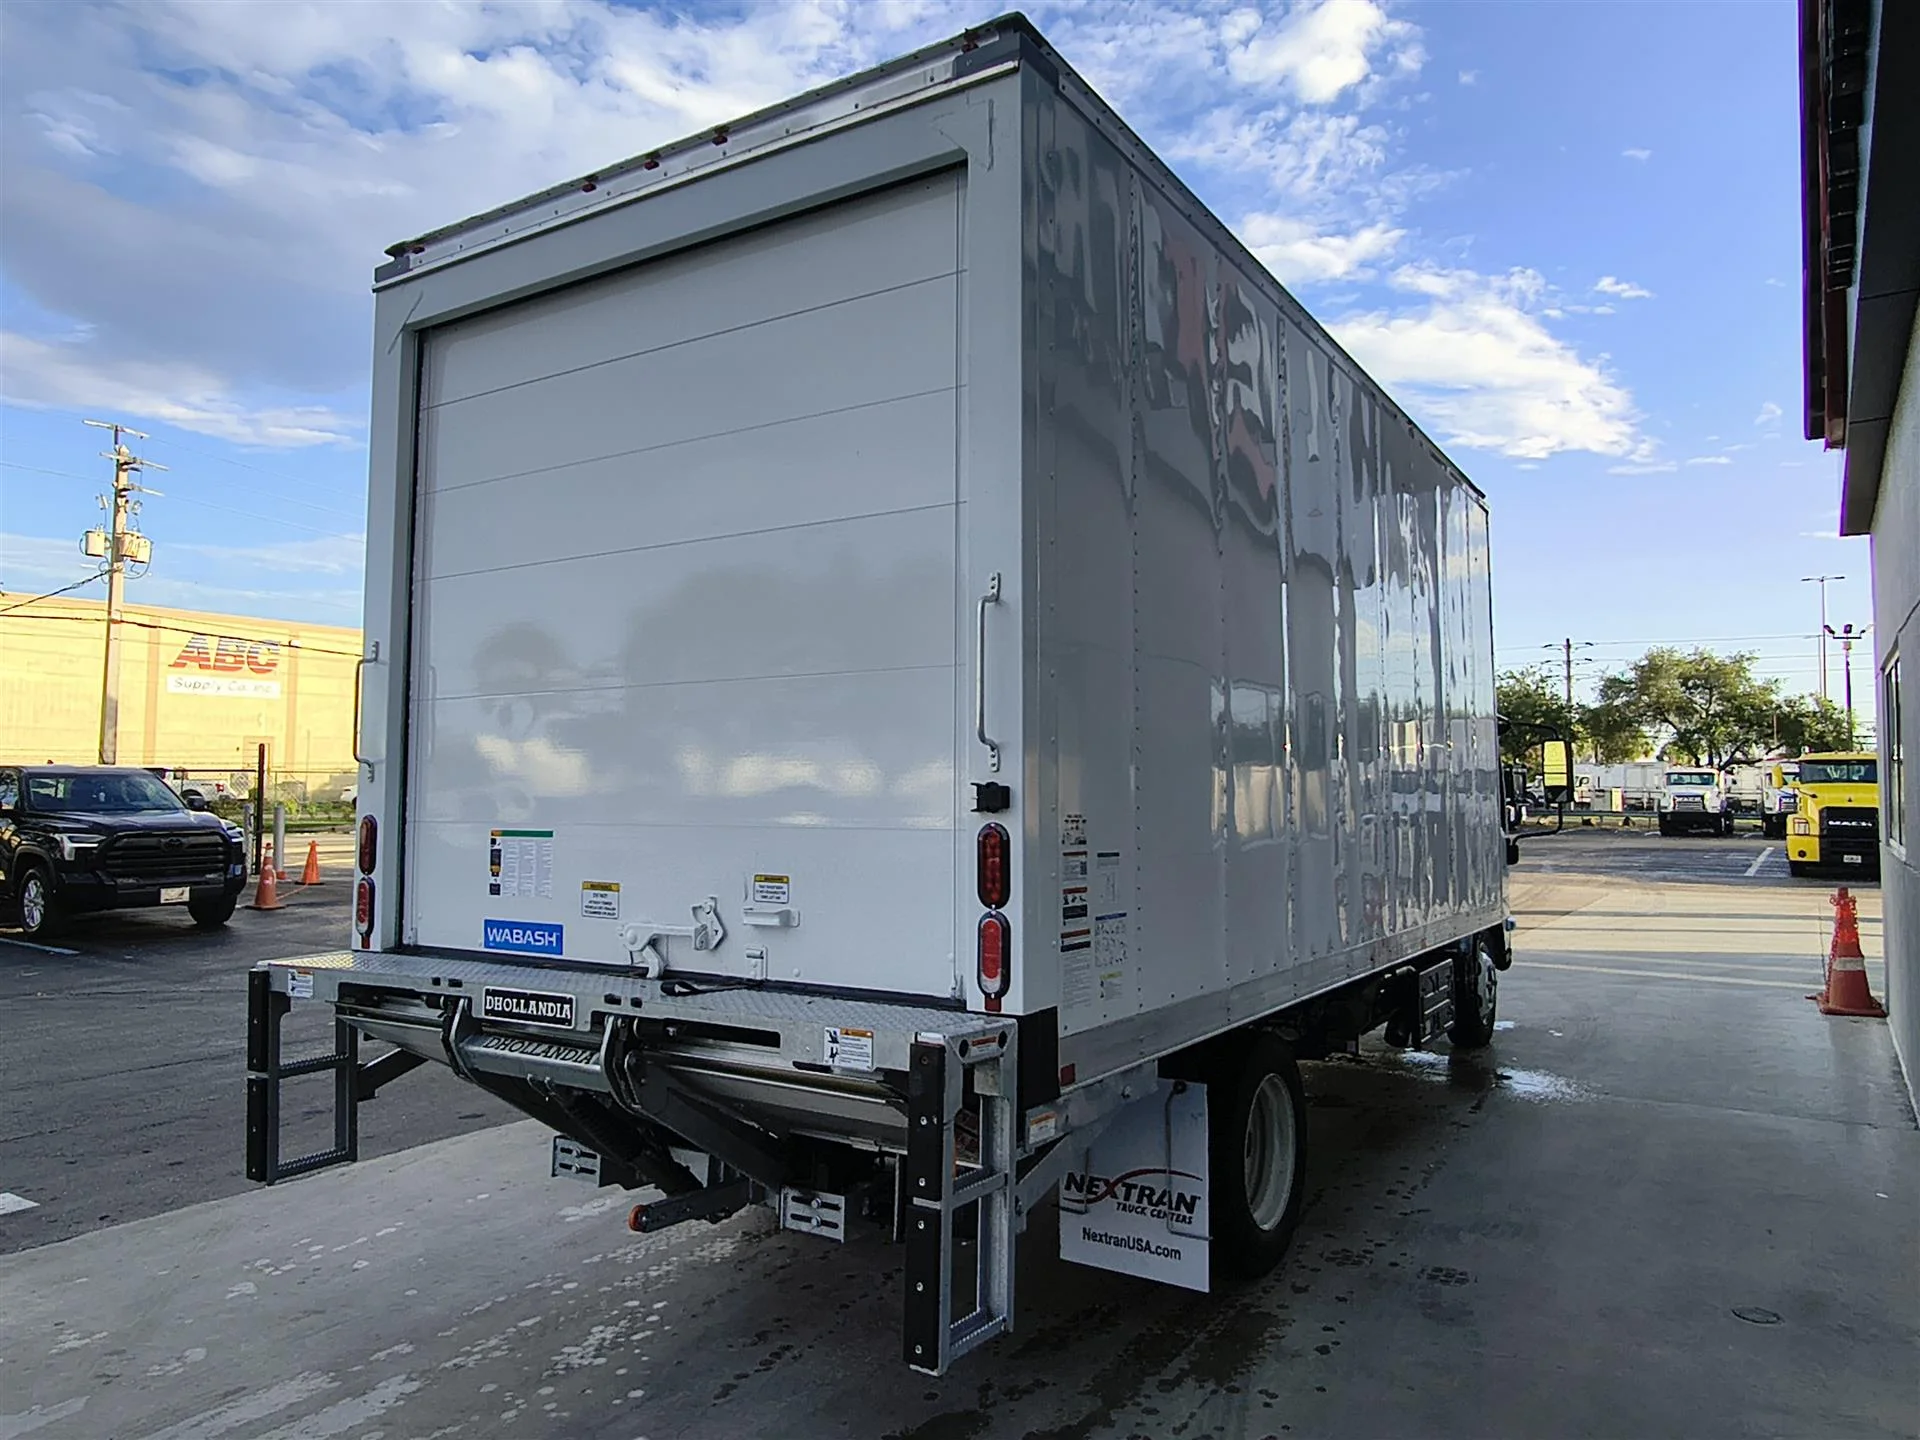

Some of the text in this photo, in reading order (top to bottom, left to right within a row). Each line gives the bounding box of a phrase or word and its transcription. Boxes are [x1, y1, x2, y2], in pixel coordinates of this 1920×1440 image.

[168, 635, 280, 674] ABC
[174, 677, 221, 694] Supply
[487, 927, 557, 947] WABASH
[485, 995, 571, 1019] DHOLLANDIA
[482, 1037, 598, 1065] DHOLLANDIA
[1064, 1172, 1199, 1214] NEXTRAN
[1116, 1202, 1193, 1225] TRUCK CENTERS
[1082, 1227, 1182, 1261] NextranUSA.com
